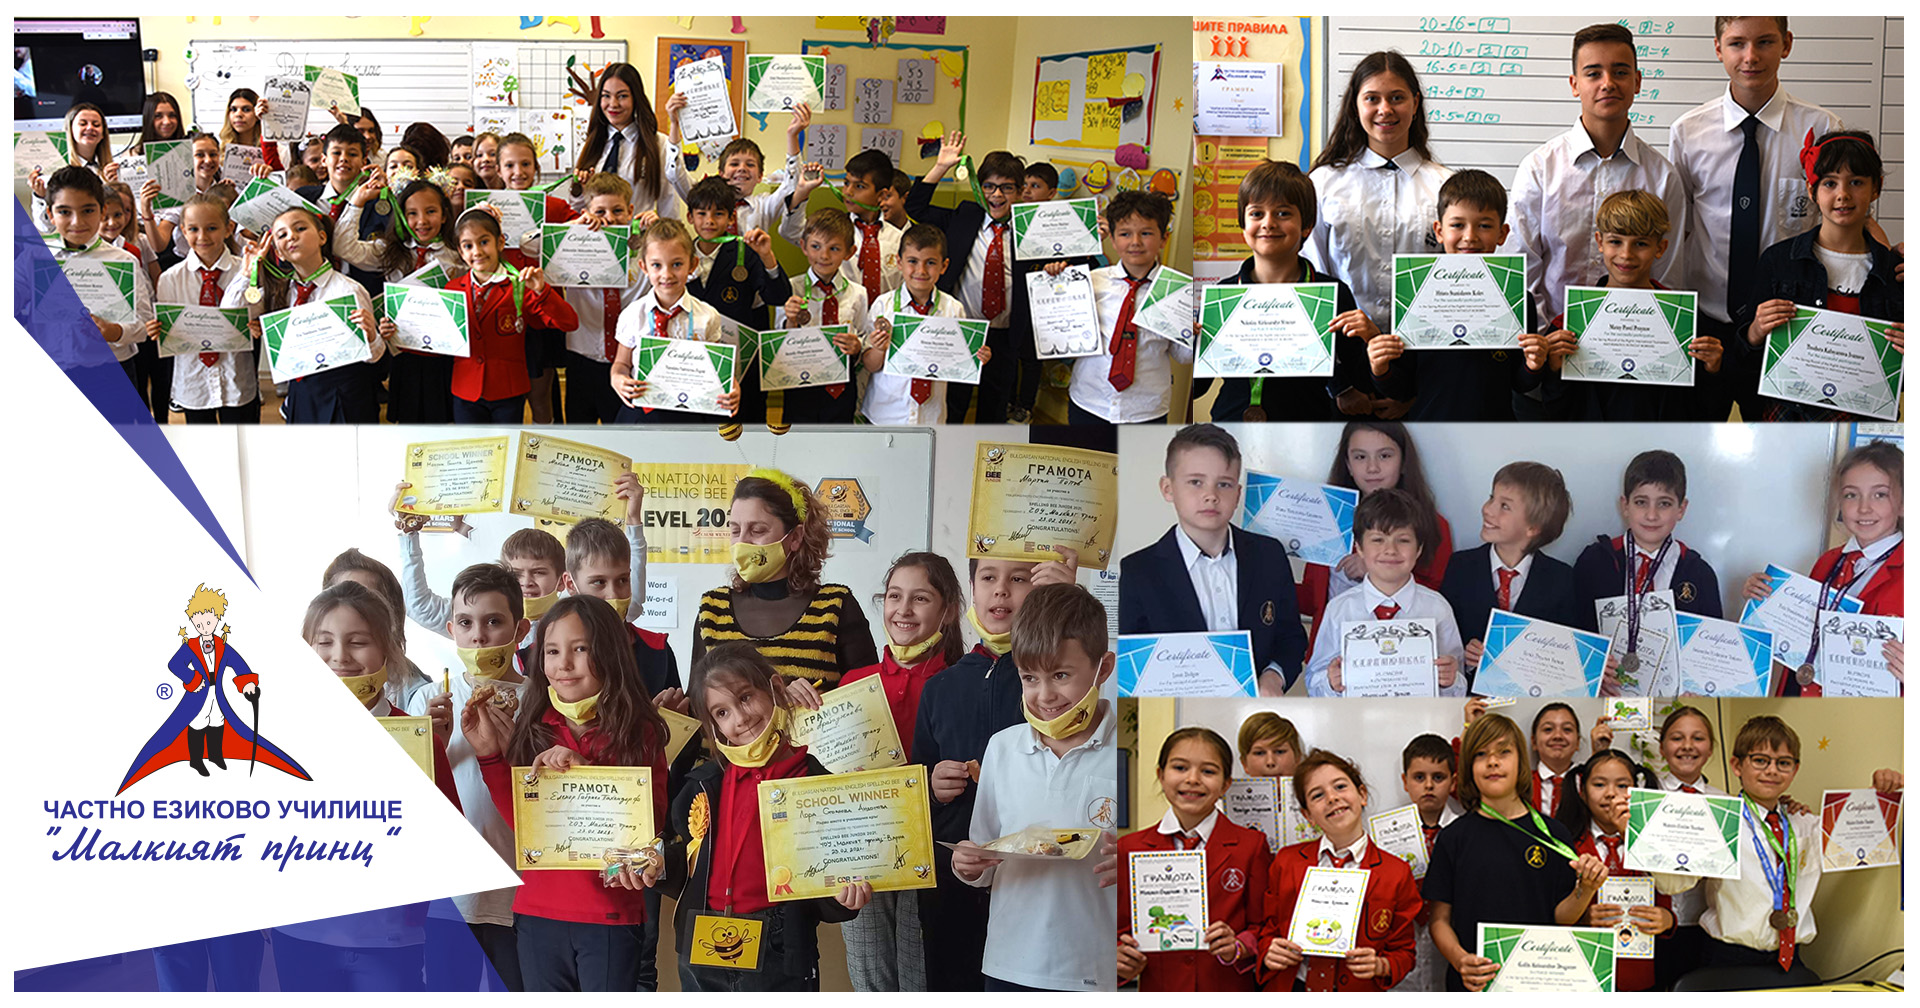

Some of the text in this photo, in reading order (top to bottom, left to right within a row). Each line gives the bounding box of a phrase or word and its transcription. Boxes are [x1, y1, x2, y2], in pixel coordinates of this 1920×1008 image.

[1228, 22, 1288, 34] ПРАВИЛА
[864, 90, 879, 99] 41
[902, 92, 921, 102] 100
[830, 101, 837, 110] 6
[865, 101, 880, 111] 39
[819, 132, 836, 145] 32
[871, 136, 896, 148] 100
[1434, 268, 1487, 284] Certificate
[1243, 298, 1296, 313] Certificate
[1604, 302, 1657, 318] Certificate
[1811, 324, 1866, 342] Certificate
[667, 348, 706, 364] Certificate
[428, 449, 494, 462] SCHOOL WINNER
[556, 452, 605, 469] ГРАМОТА
[636, 473, 727, 485] AN NATIONAL
[1028, 464, 1092, 480] ГРАМОТА
[644, 487, 727, 499] PELLING BEE
[1278, 490, 1323, 505] Certificate
[644, 510, 693, 528] EVEL
[1027, 524, 1080, 534] CONGRATULATIONS!
[1784, 586, 1819, 608] Certifica
[1524, 632, 1571, 651] Certificate
[1699, 630, 1740, 647] Certificate
[1156, 648, 1212, 665] Certificate
[804, 701, 854, 727] ГРАМОТА
[562, 783, 618, 794] ГРАМОТА
[796, 788, 899, 809] SCHOOL WINNER
[1662, 804, 1707, 818] Certificate
[823, 853, 880, 865] CONGRATULATIONS!
[1521, 940, 1575, 956] Certificate
